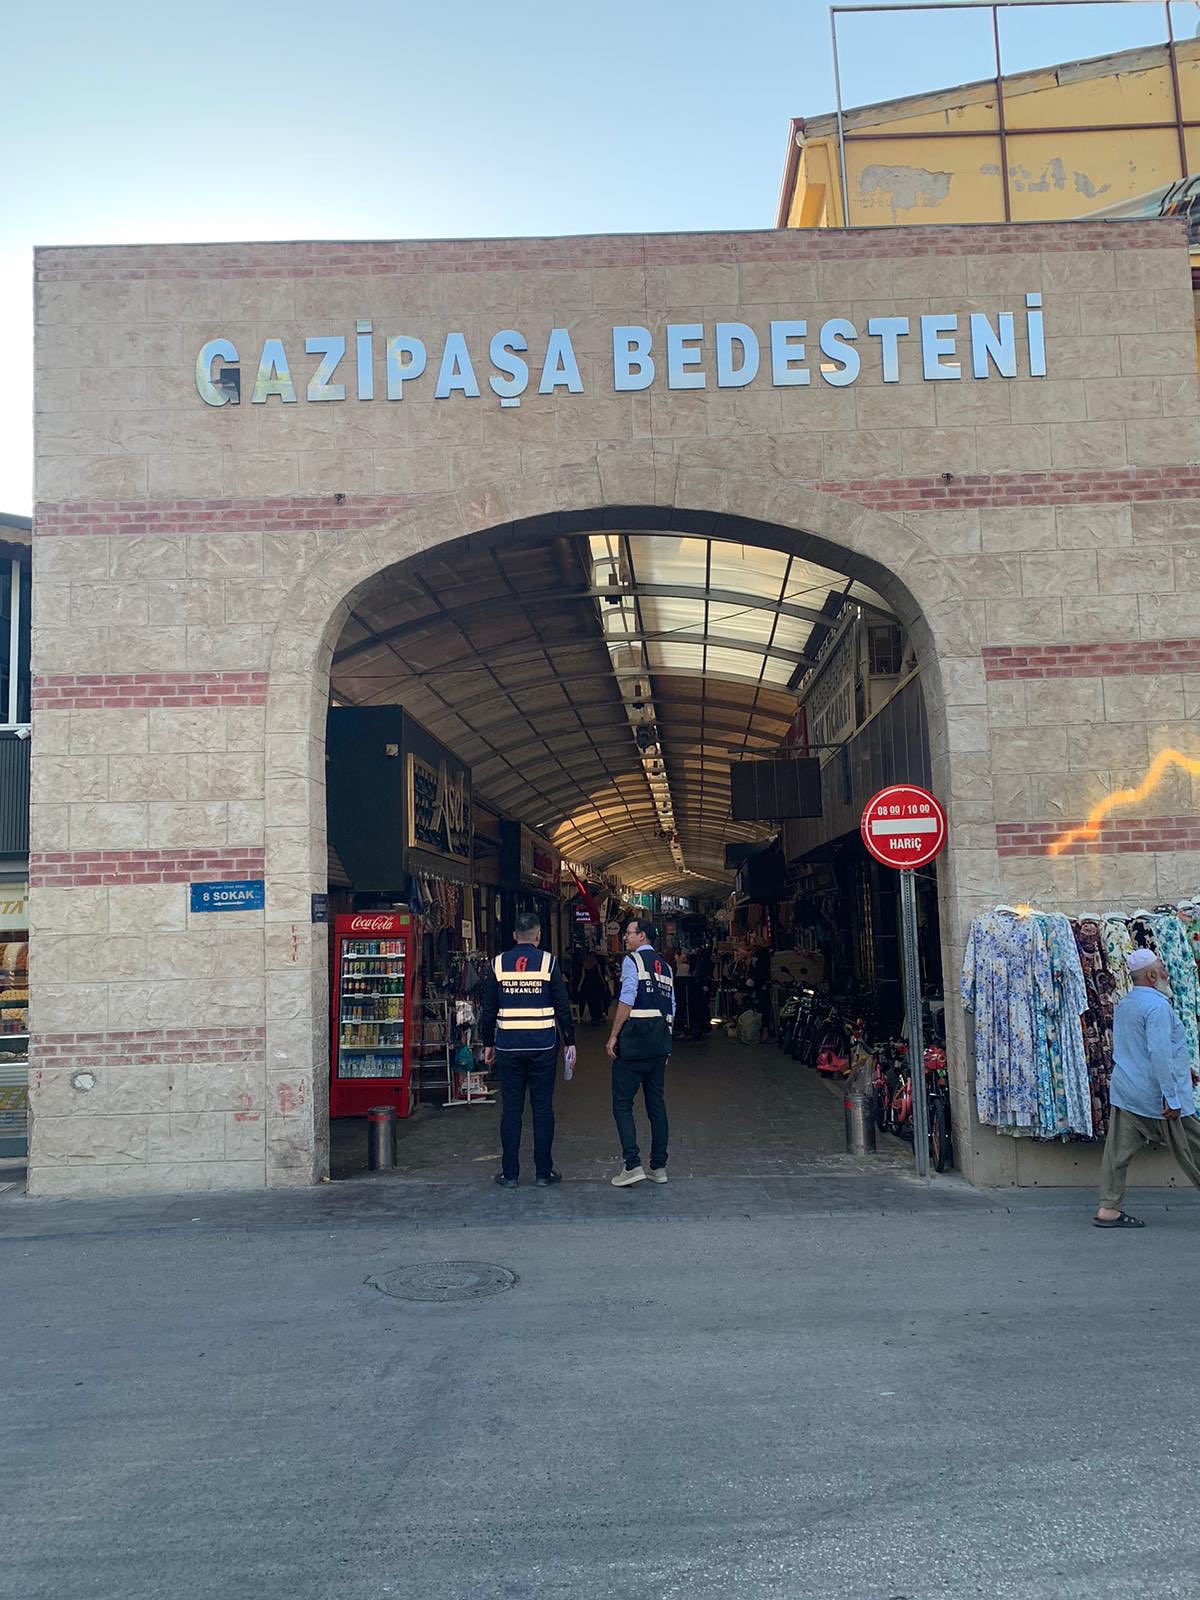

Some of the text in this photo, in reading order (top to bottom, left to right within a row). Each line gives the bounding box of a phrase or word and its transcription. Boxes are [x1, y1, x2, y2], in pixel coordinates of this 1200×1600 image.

[195, 292, 1047, 408] GAZİPAŞA BEDESTENİ
[877, 806, 888, 816] 08
[889, 805, 900, 816] 00
[907, 804, 917, 815] 10
[919, 804, 930, 814] 00
[890, 838, 921, 851] HARİÇ
[203, 890, 254, 901] 8 SOKAK
[351, 915, 394, 931] Coca-Cola
